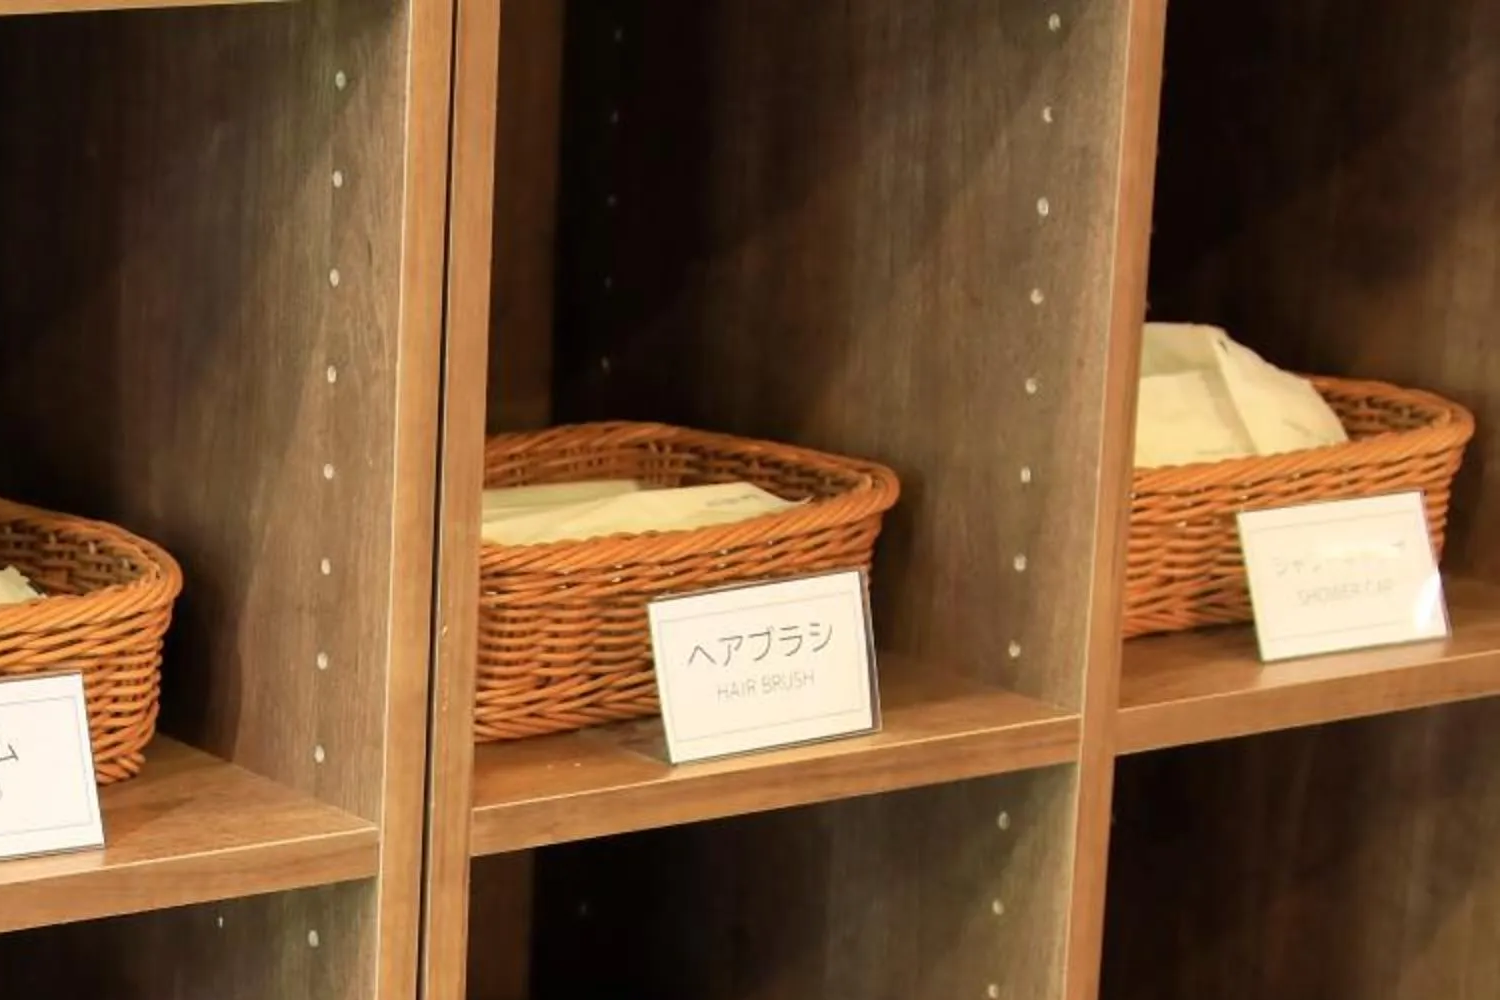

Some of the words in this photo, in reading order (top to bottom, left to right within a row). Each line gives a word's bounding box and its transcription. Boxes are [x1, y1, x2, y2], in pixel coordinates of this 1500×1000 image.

[687, 622, 834, 667] ヘアブラシ
[716, 678, 758, 703] HAIR
[760, 669, 816, 696] BRUSH
